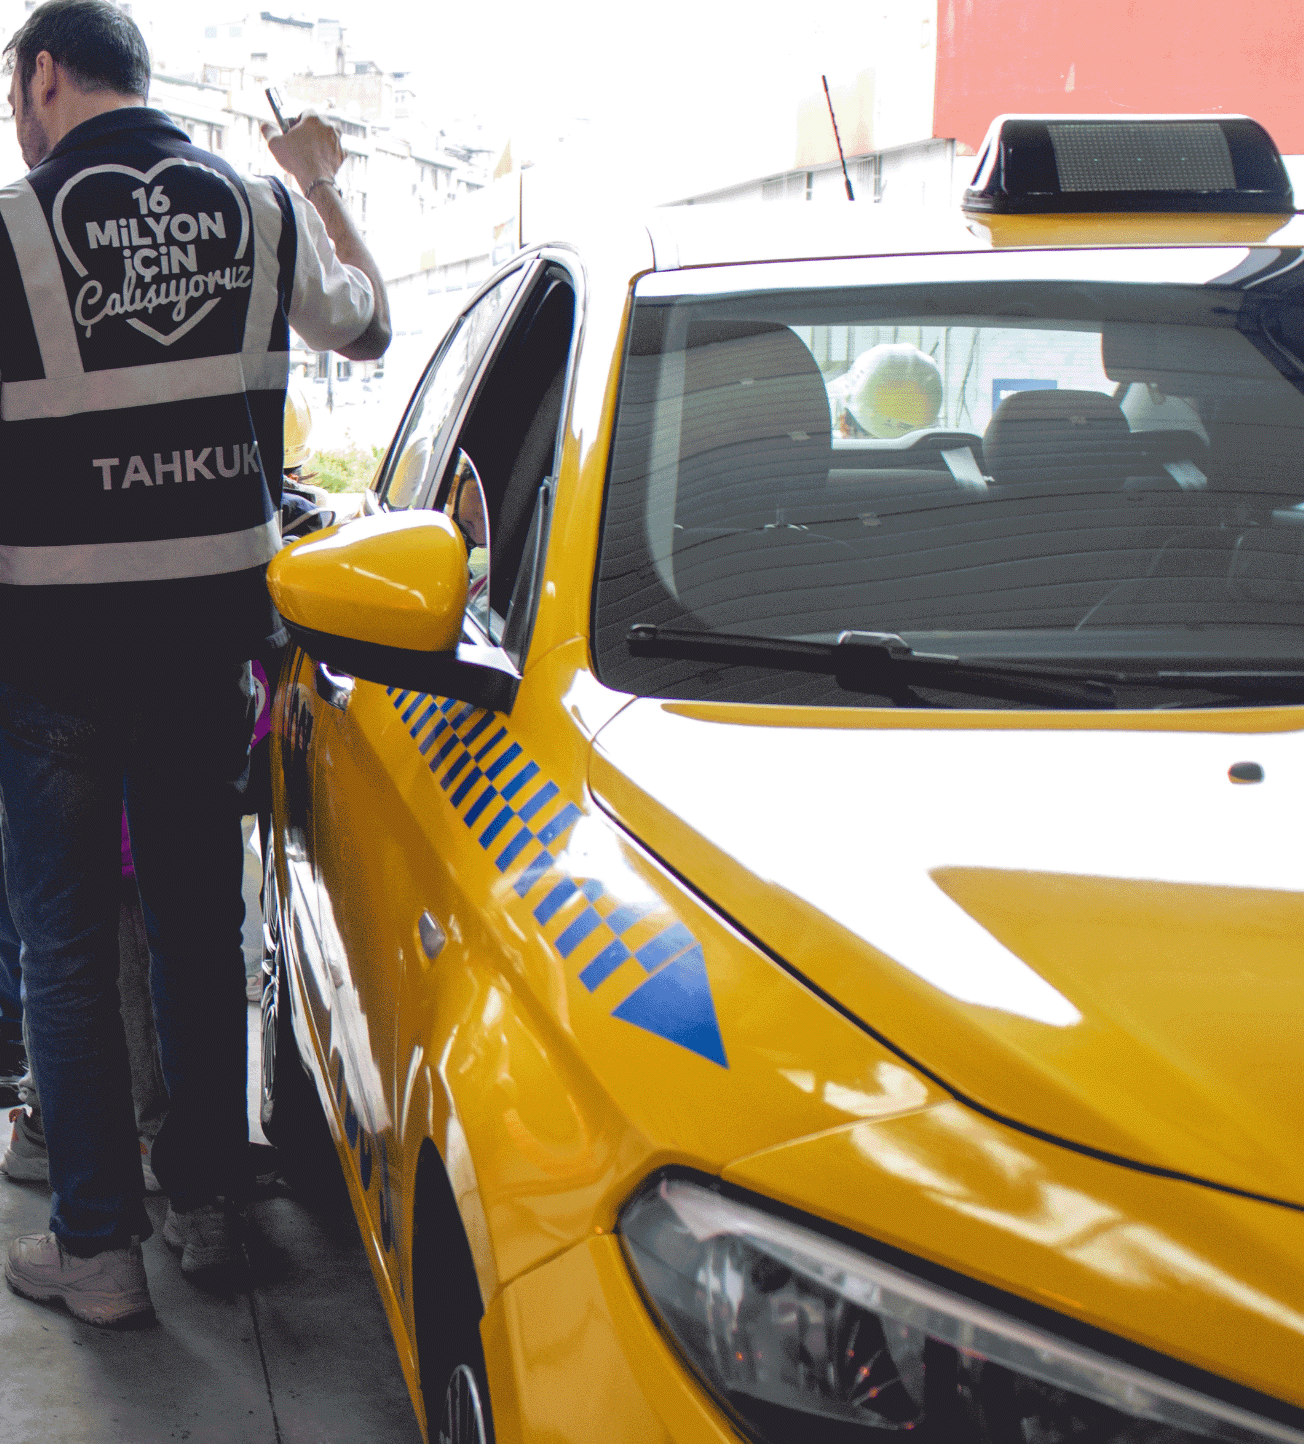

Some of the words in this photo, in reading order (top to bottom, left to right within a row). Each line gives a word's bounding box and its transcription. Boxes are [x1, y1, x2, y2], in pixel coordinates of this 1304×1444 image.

[132, 185, 171, 215] 16
[85, 211, 227, 249] MİLYON
[122, 244, 198, 283] İÇİN
[92, 442, 260, 491] TAHKUK
